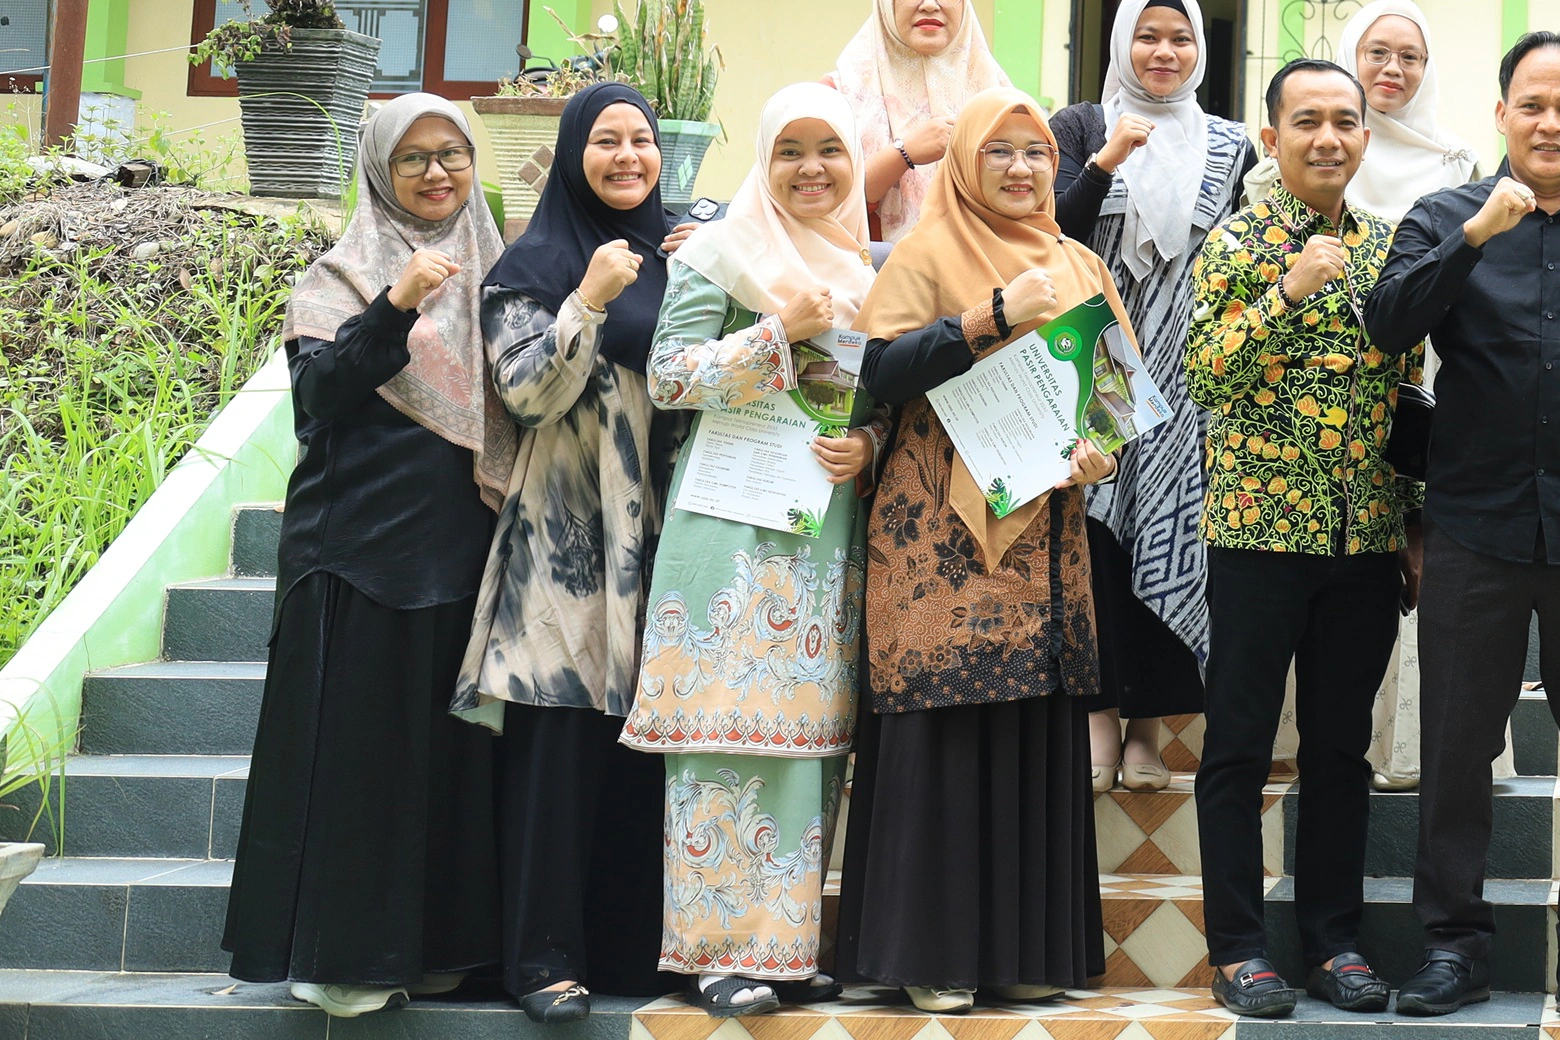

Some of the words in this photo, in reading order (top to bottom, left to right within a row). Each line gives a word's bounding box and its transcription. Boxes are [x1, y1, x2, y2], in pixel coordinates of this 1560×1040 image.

[1029, 343, 1063, 396] UNIVERSITAS
[1019, 349, 1038, 374] PASIR
[1034, 374, 1070, 432] PENGARAIAN
[721, 404, 741, 415] ASIR
[744, 409, 806, 429] PENGARAIAN
[708, 430, 731, 438] FAKULTAS
[744, 437, 768, 446] PROGRAM
